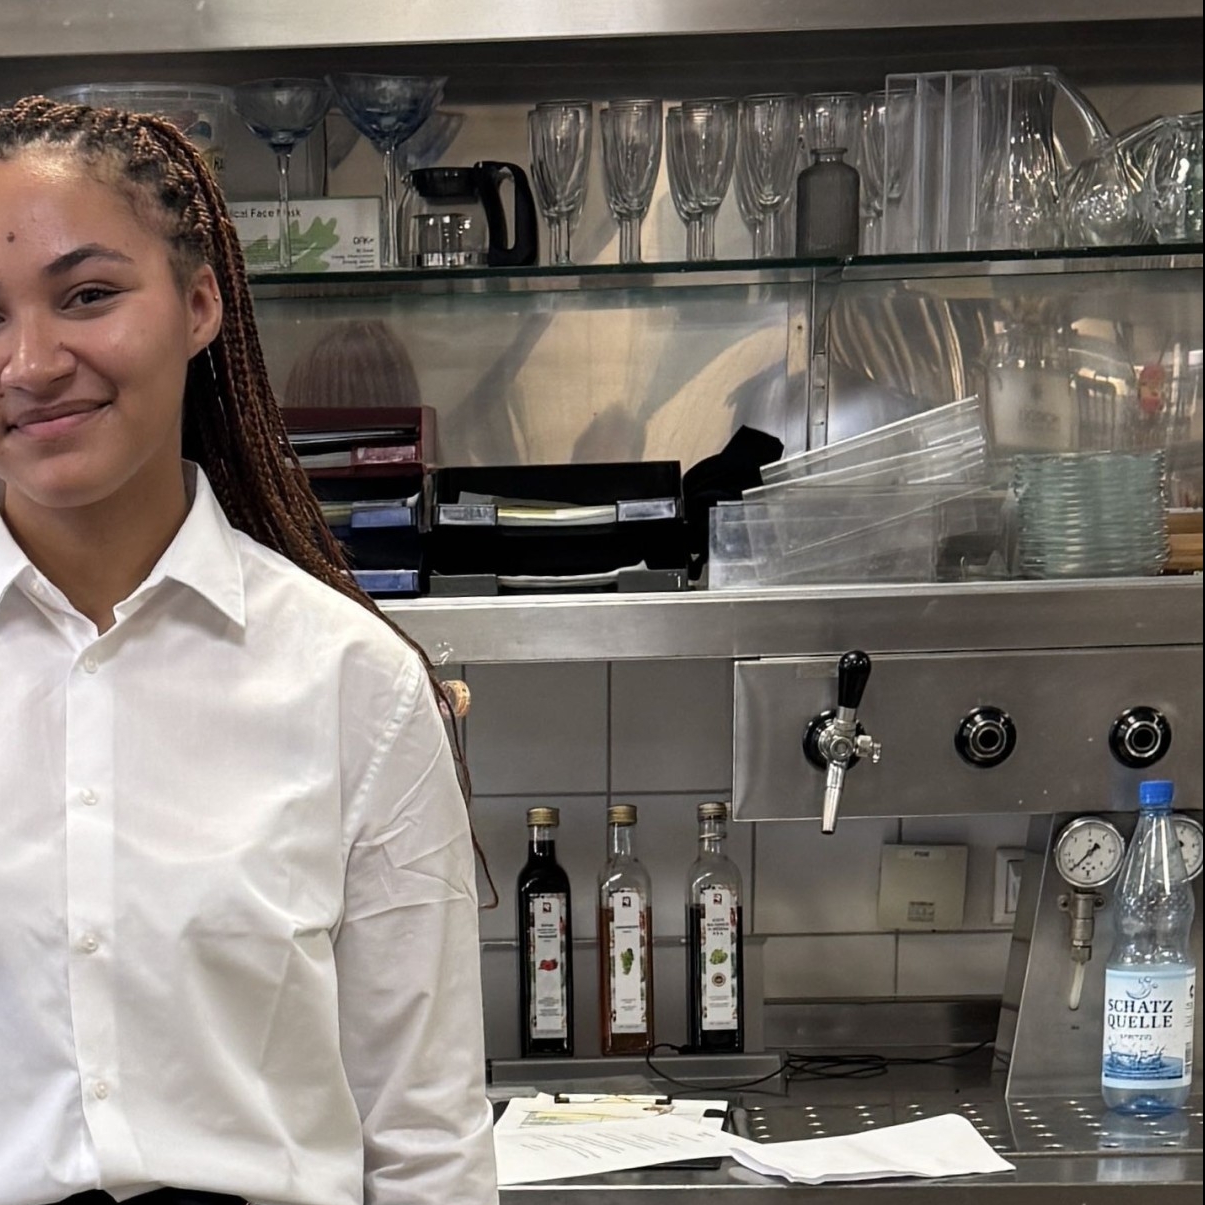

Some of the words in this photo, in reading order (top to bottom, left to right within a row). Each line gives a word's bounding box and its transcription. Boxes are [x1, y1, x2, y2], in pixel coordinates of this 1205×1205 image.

[251, 209, 274, 218] Face
[1108, 999, 1173, 1013] SCHATZ
[1108, 1014, 1173, 1029] QUELLE
